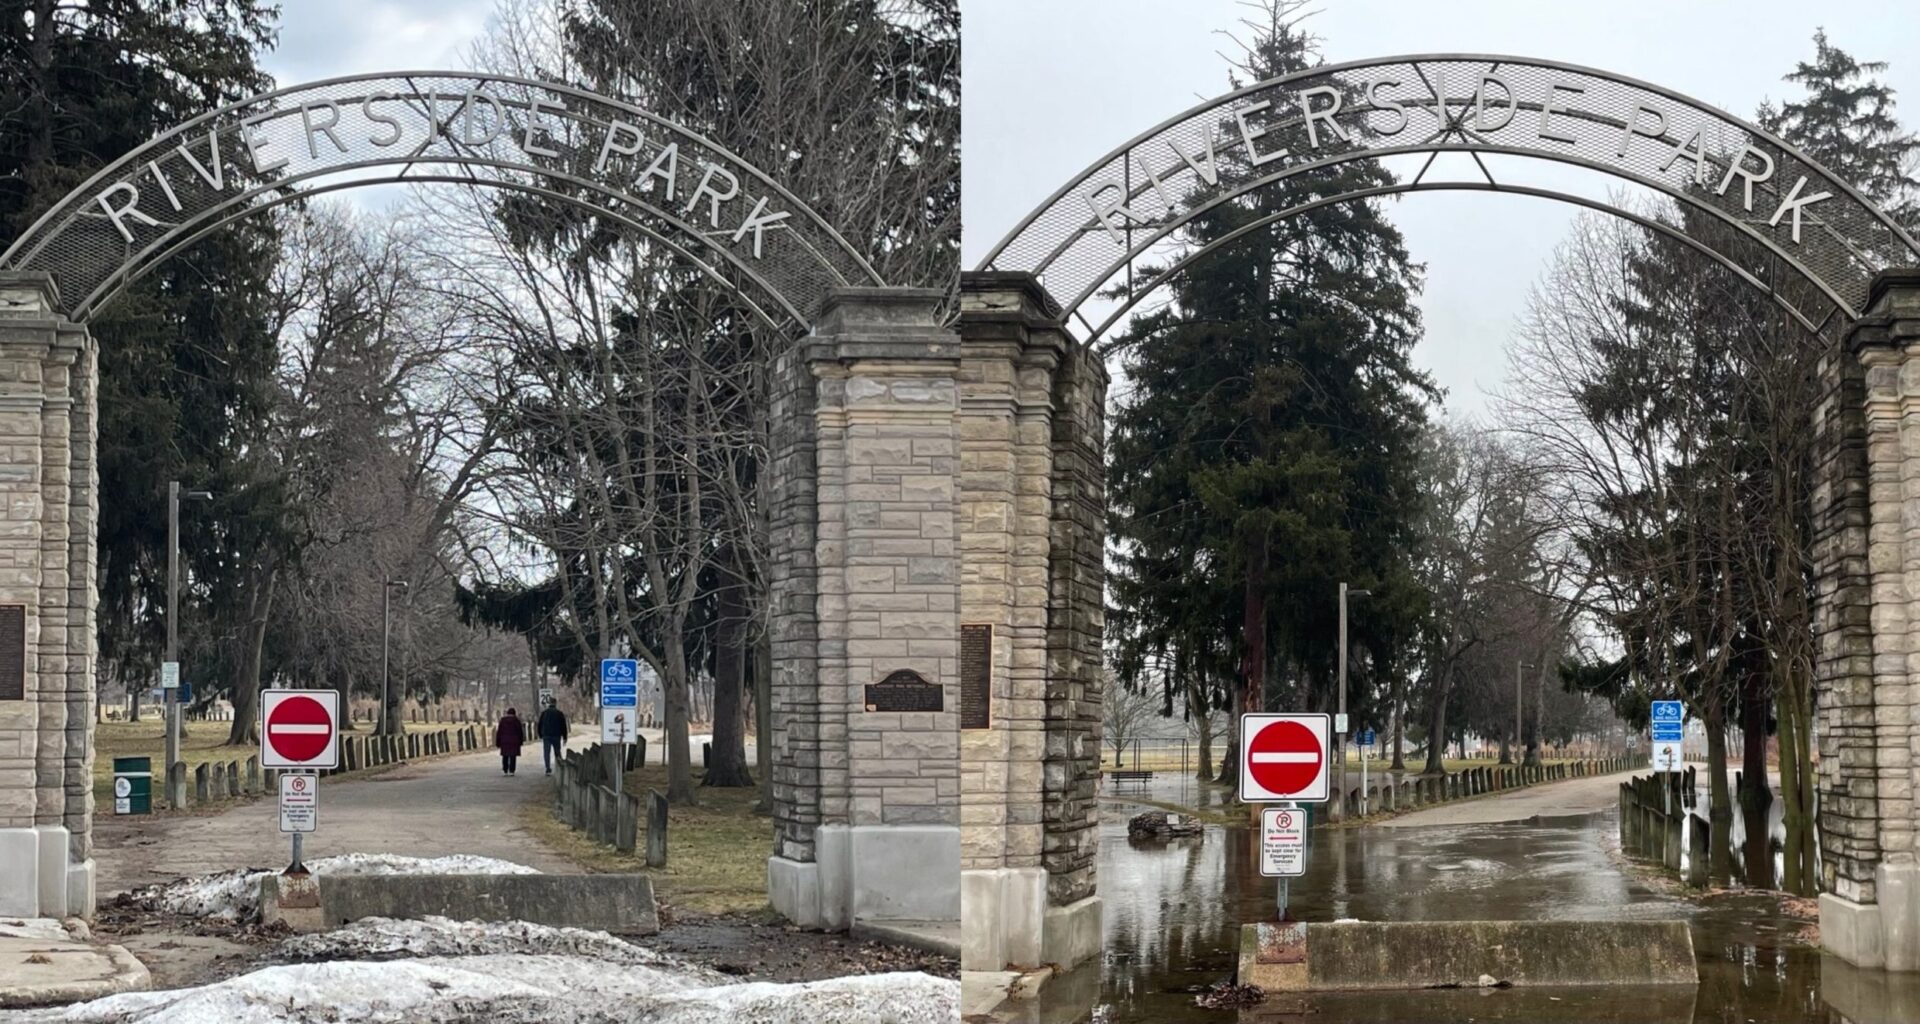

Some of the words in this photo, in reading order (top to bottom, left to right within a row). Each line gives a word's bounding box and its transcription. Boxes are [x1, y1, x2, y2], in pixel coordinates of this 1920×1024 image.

[97, 88, 567, 243] RIVERSIDE
[599, 119, 790, 259] PARK
[1082, 71, 1585, 243] RIVERSIDE
[1618, 100, 1833, 243] PARK
